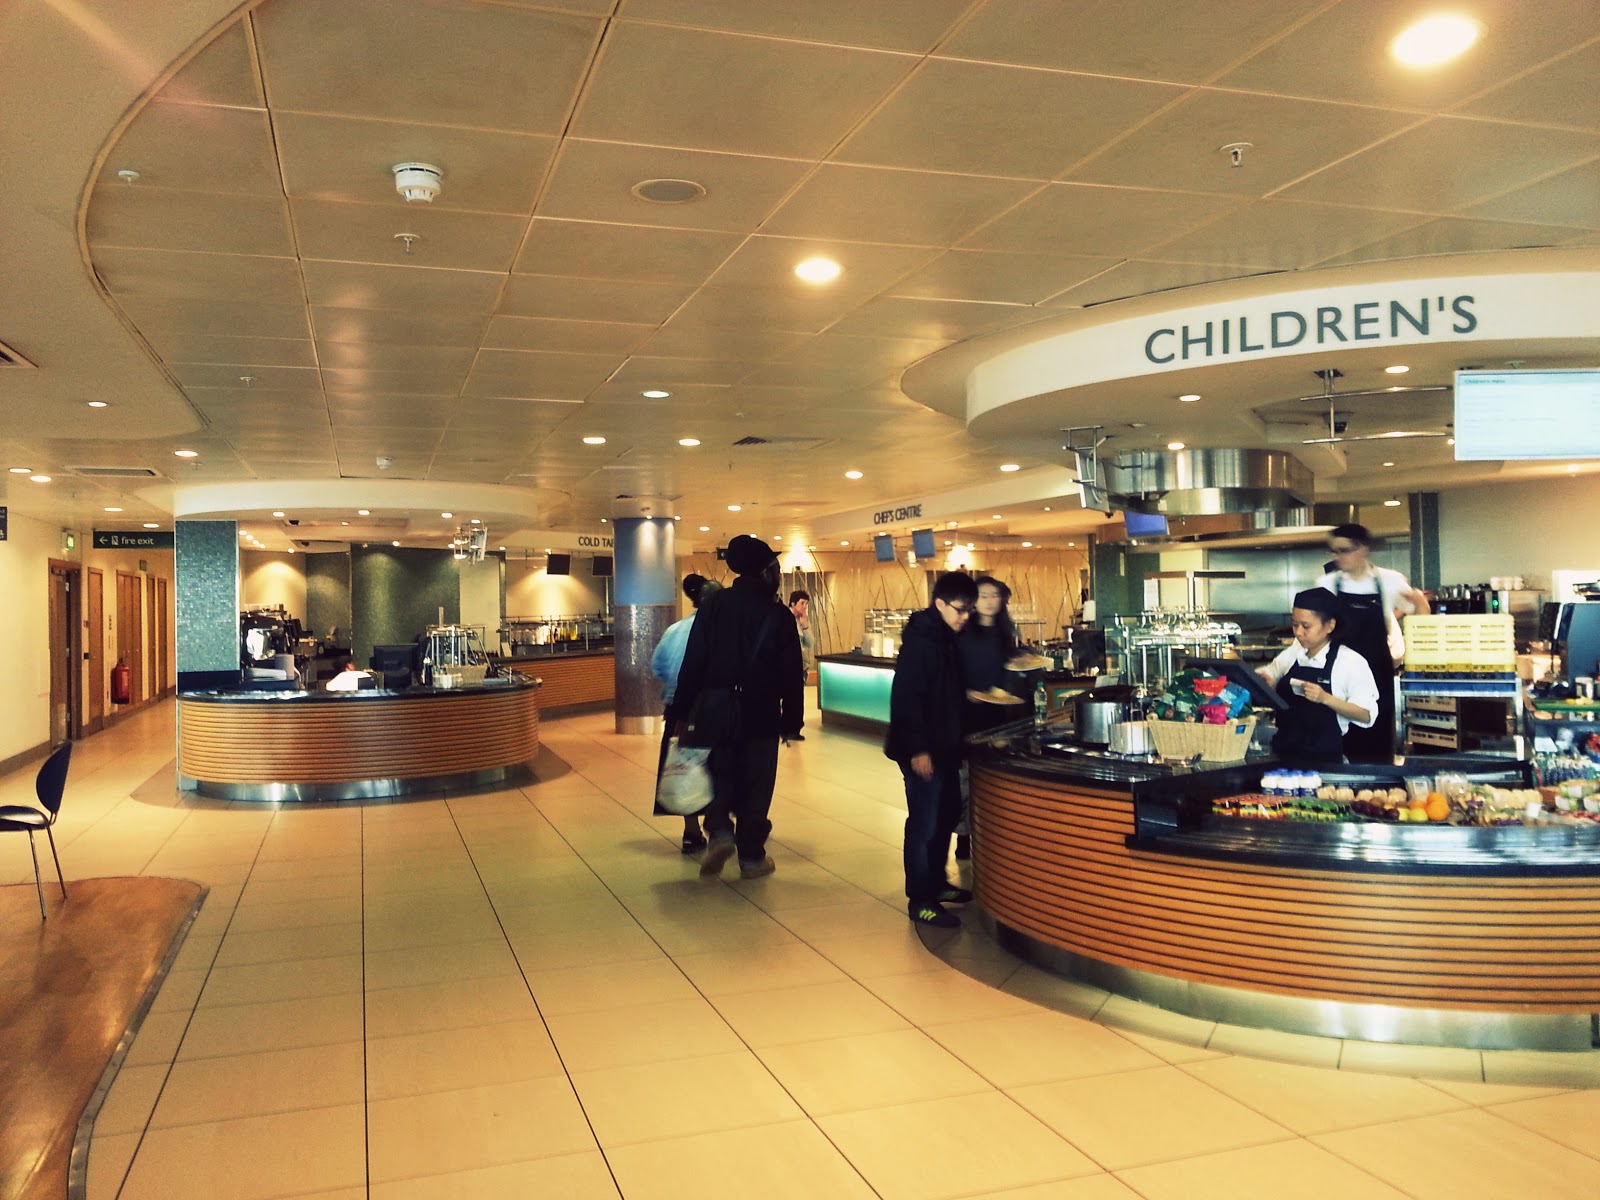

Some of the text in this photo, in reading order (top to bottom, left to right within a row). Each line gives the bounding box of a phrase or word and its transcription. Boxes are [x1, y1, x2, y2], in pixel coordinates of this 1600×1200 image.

[1144, 295, 1478, 365] CHILDREN'S
[874, 504, 922, 524] CHEF'S CENTRE
[121, 536, 155, 545] fire exit
[578, 536, 599, 547] COLD
